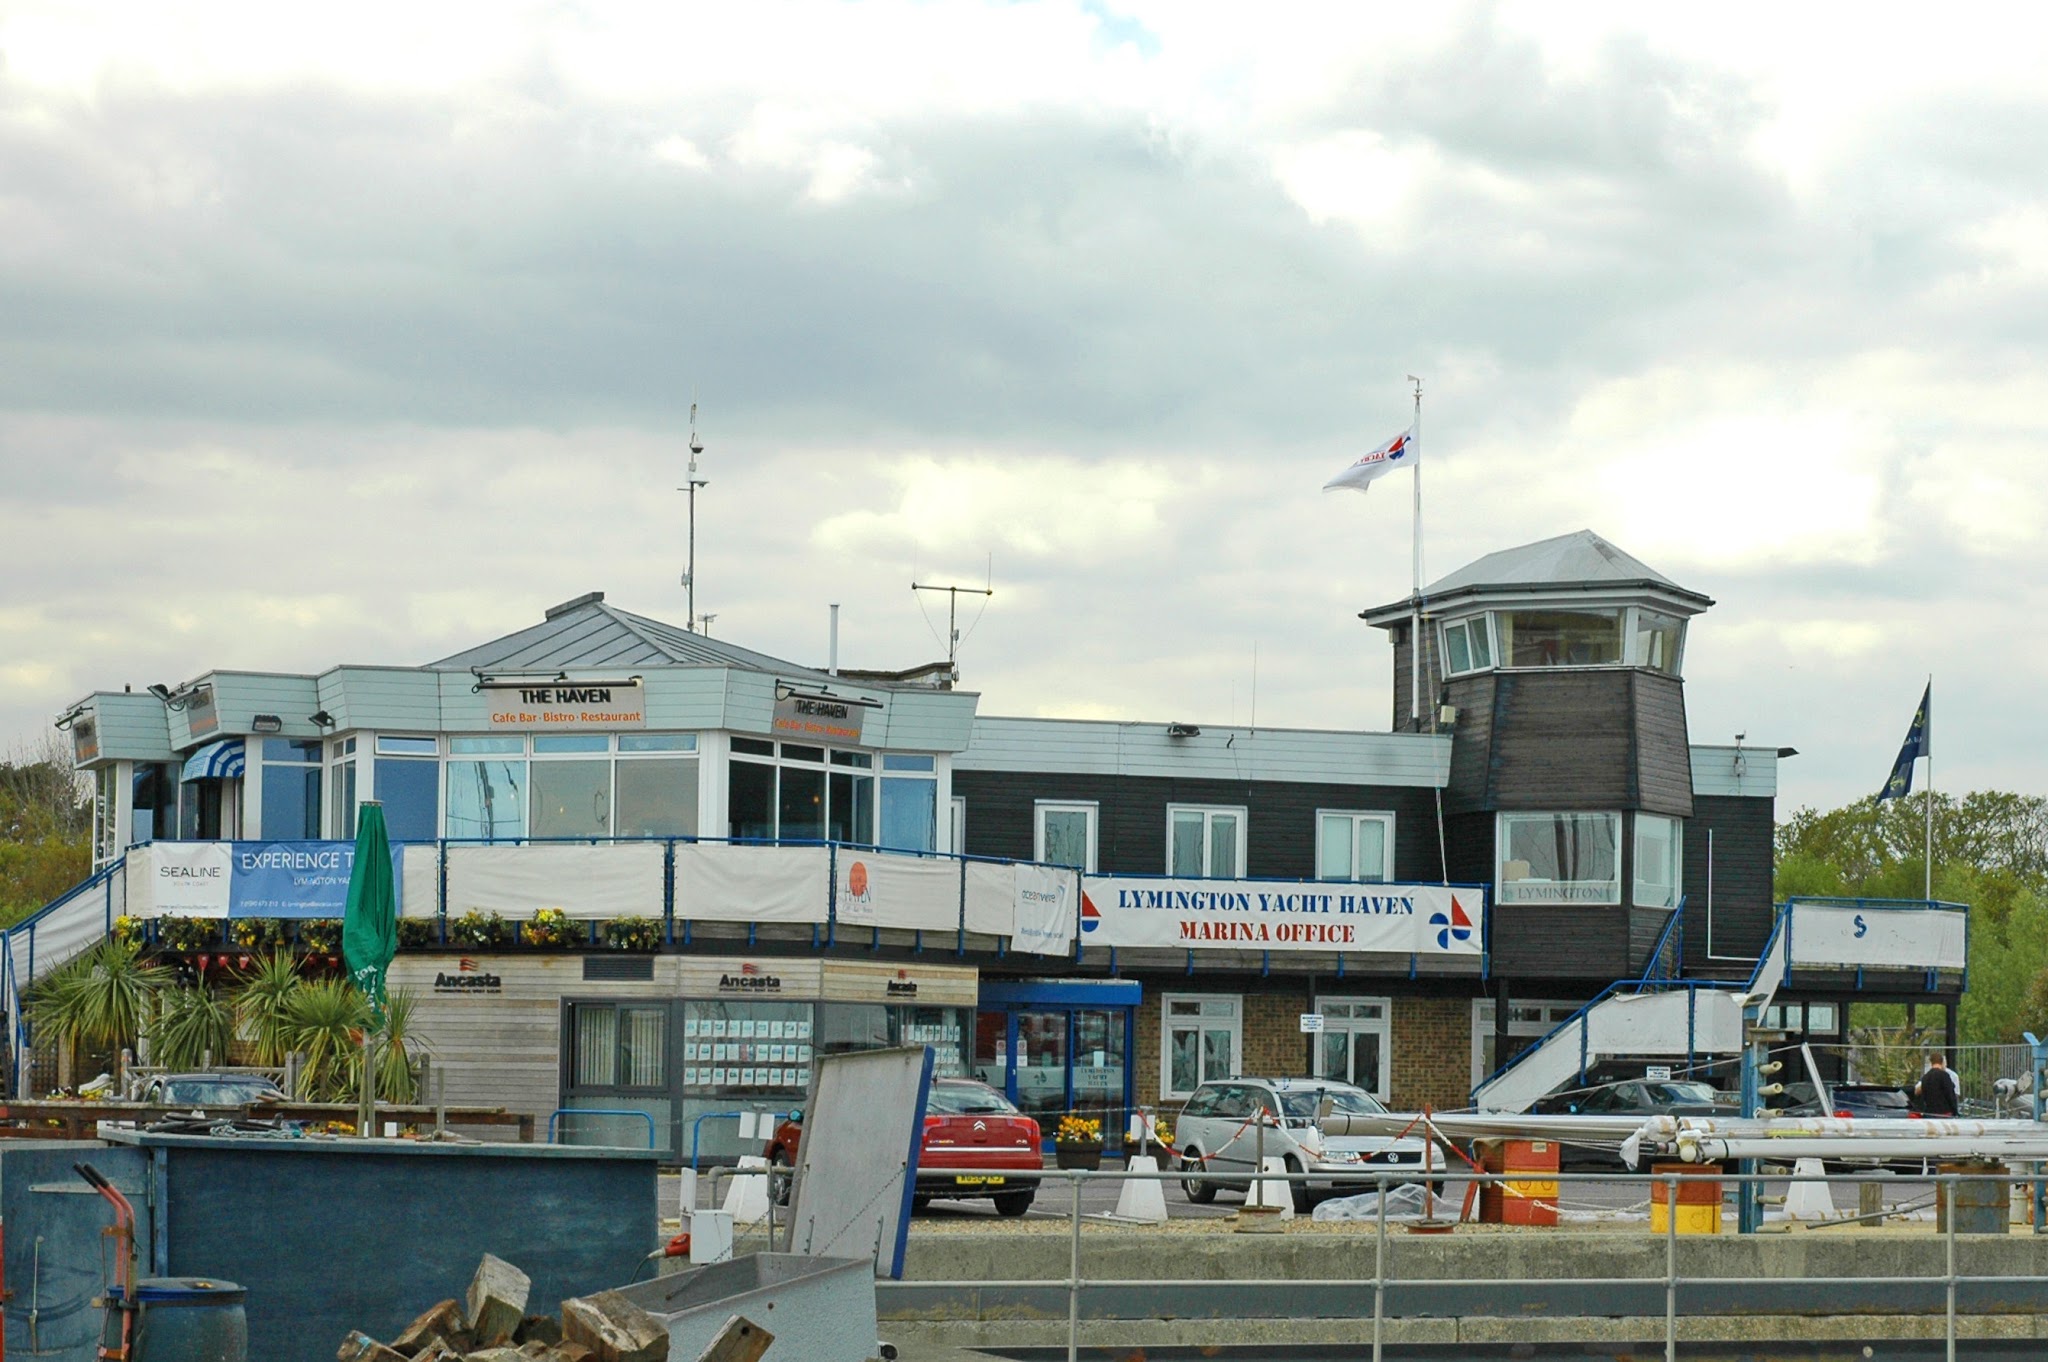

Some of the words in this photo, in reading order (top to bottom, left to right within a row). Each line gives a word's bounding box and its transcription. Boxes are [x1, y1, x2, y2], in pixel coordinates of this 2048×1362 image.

[519, 689, 553, 704] THE
[556, 688, 612, 703] HAVEN
[794, 699, 817, 715] THE
[816, 702, 849, 719] HAVEN
[492, 712, 516, 723] Cafe
[519, 712, 537, 722] Bar
[543, 712, 575, 722] Bistro
[581, 711, 641, 722] Restaurant
[242, 852, 339, 869] EXPERIENCE
[160, 866, 221, 878] SEALINE
[1518, 887, 1604, 900] LYMINGTON
[1119, 889, 1251, 912] LYMINGTON
[1257, 893, 1333, 913] YACHT
[1339, 895, 1415, 915] HAVEN
[1180, 921, 1270, 941] MARINA
[1275, 923, 1355, 943] OFFICE
[434, 972, 502, 987] Ancasta
[719, 974, 781, 987] Ancasta
